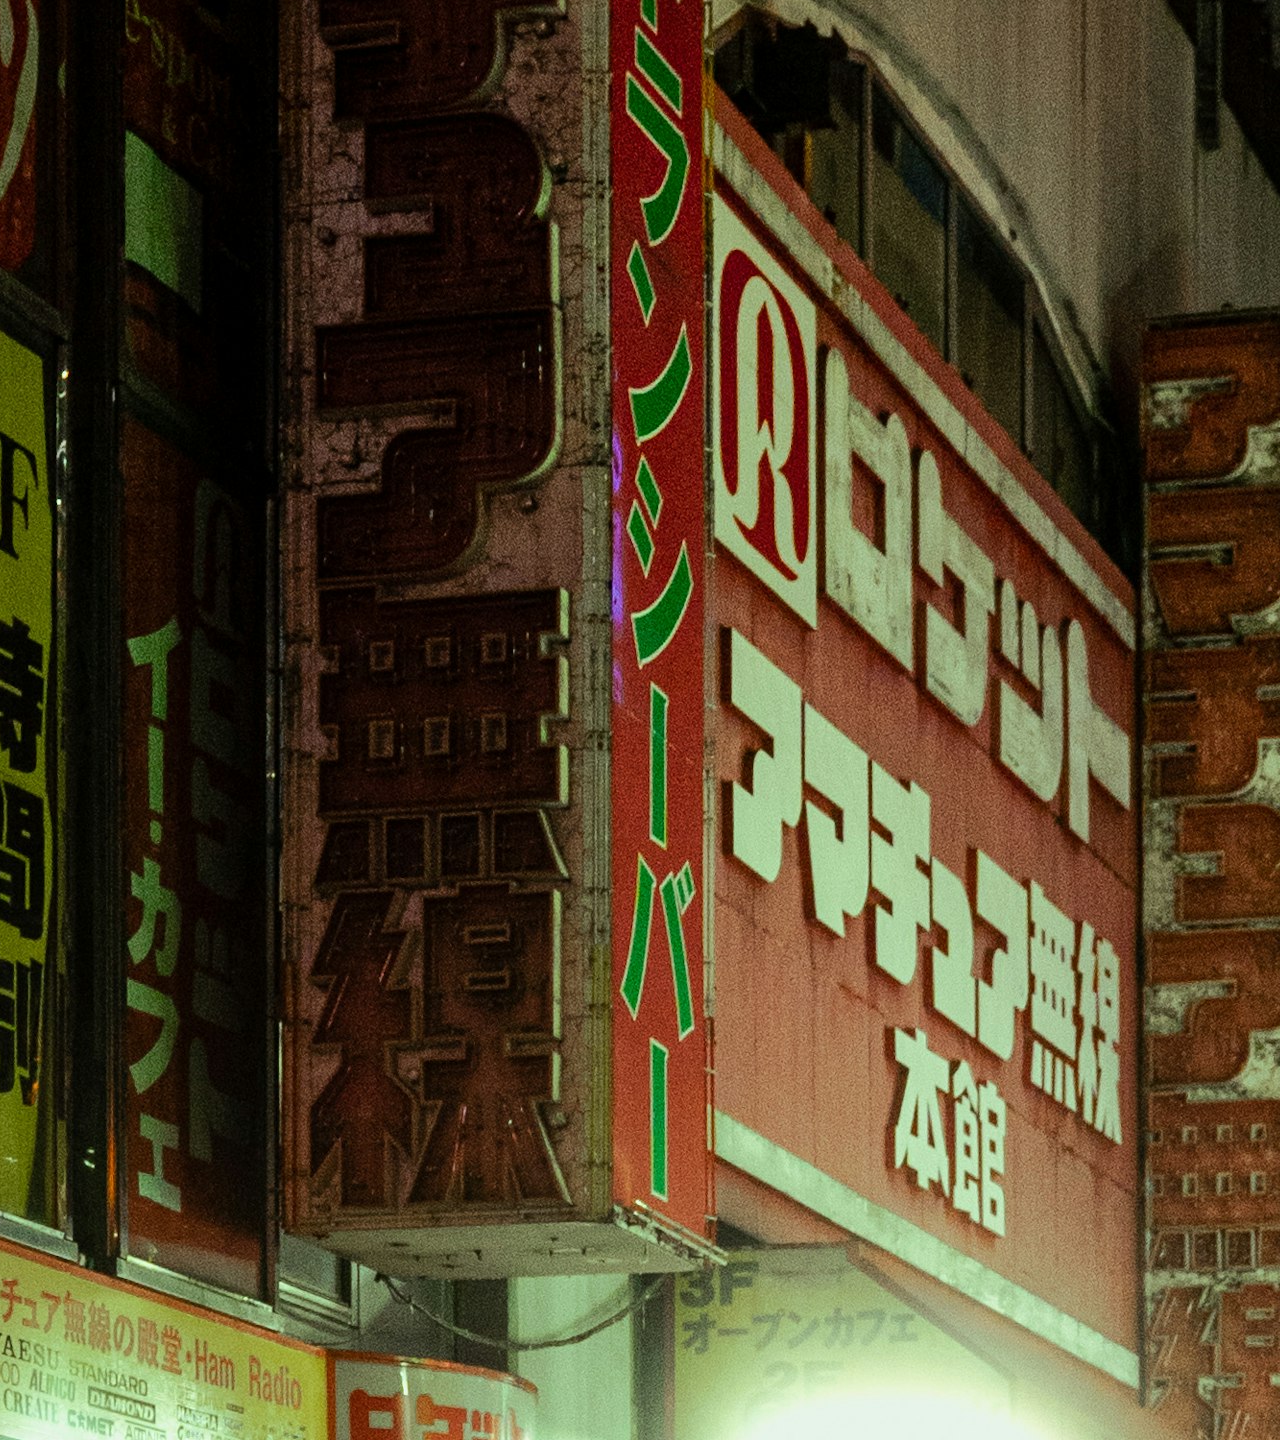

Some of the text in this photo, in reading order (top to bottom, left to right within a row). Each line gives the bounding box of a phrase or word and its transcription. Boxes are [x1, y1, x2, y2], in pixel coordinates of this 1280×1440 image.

[818, 348, 1131, 850] ロケット
[725, 628, 1122, 1146] アマチュア無線
[892, 1026, 1008, 1240] 本館
[680, 1262, 760, 1308] 3F
[681, 1309, 920, 1356] オープンカフェ
[29, 1370, 76, 1402] ALINCO
[90, 1387, 153, 1421] DIAMOND
[69, 1361, 148, 1398] STANDARD
[247, 1354, 304, 1410] Radio
[3, 1388, 60, 1425] CREATE
